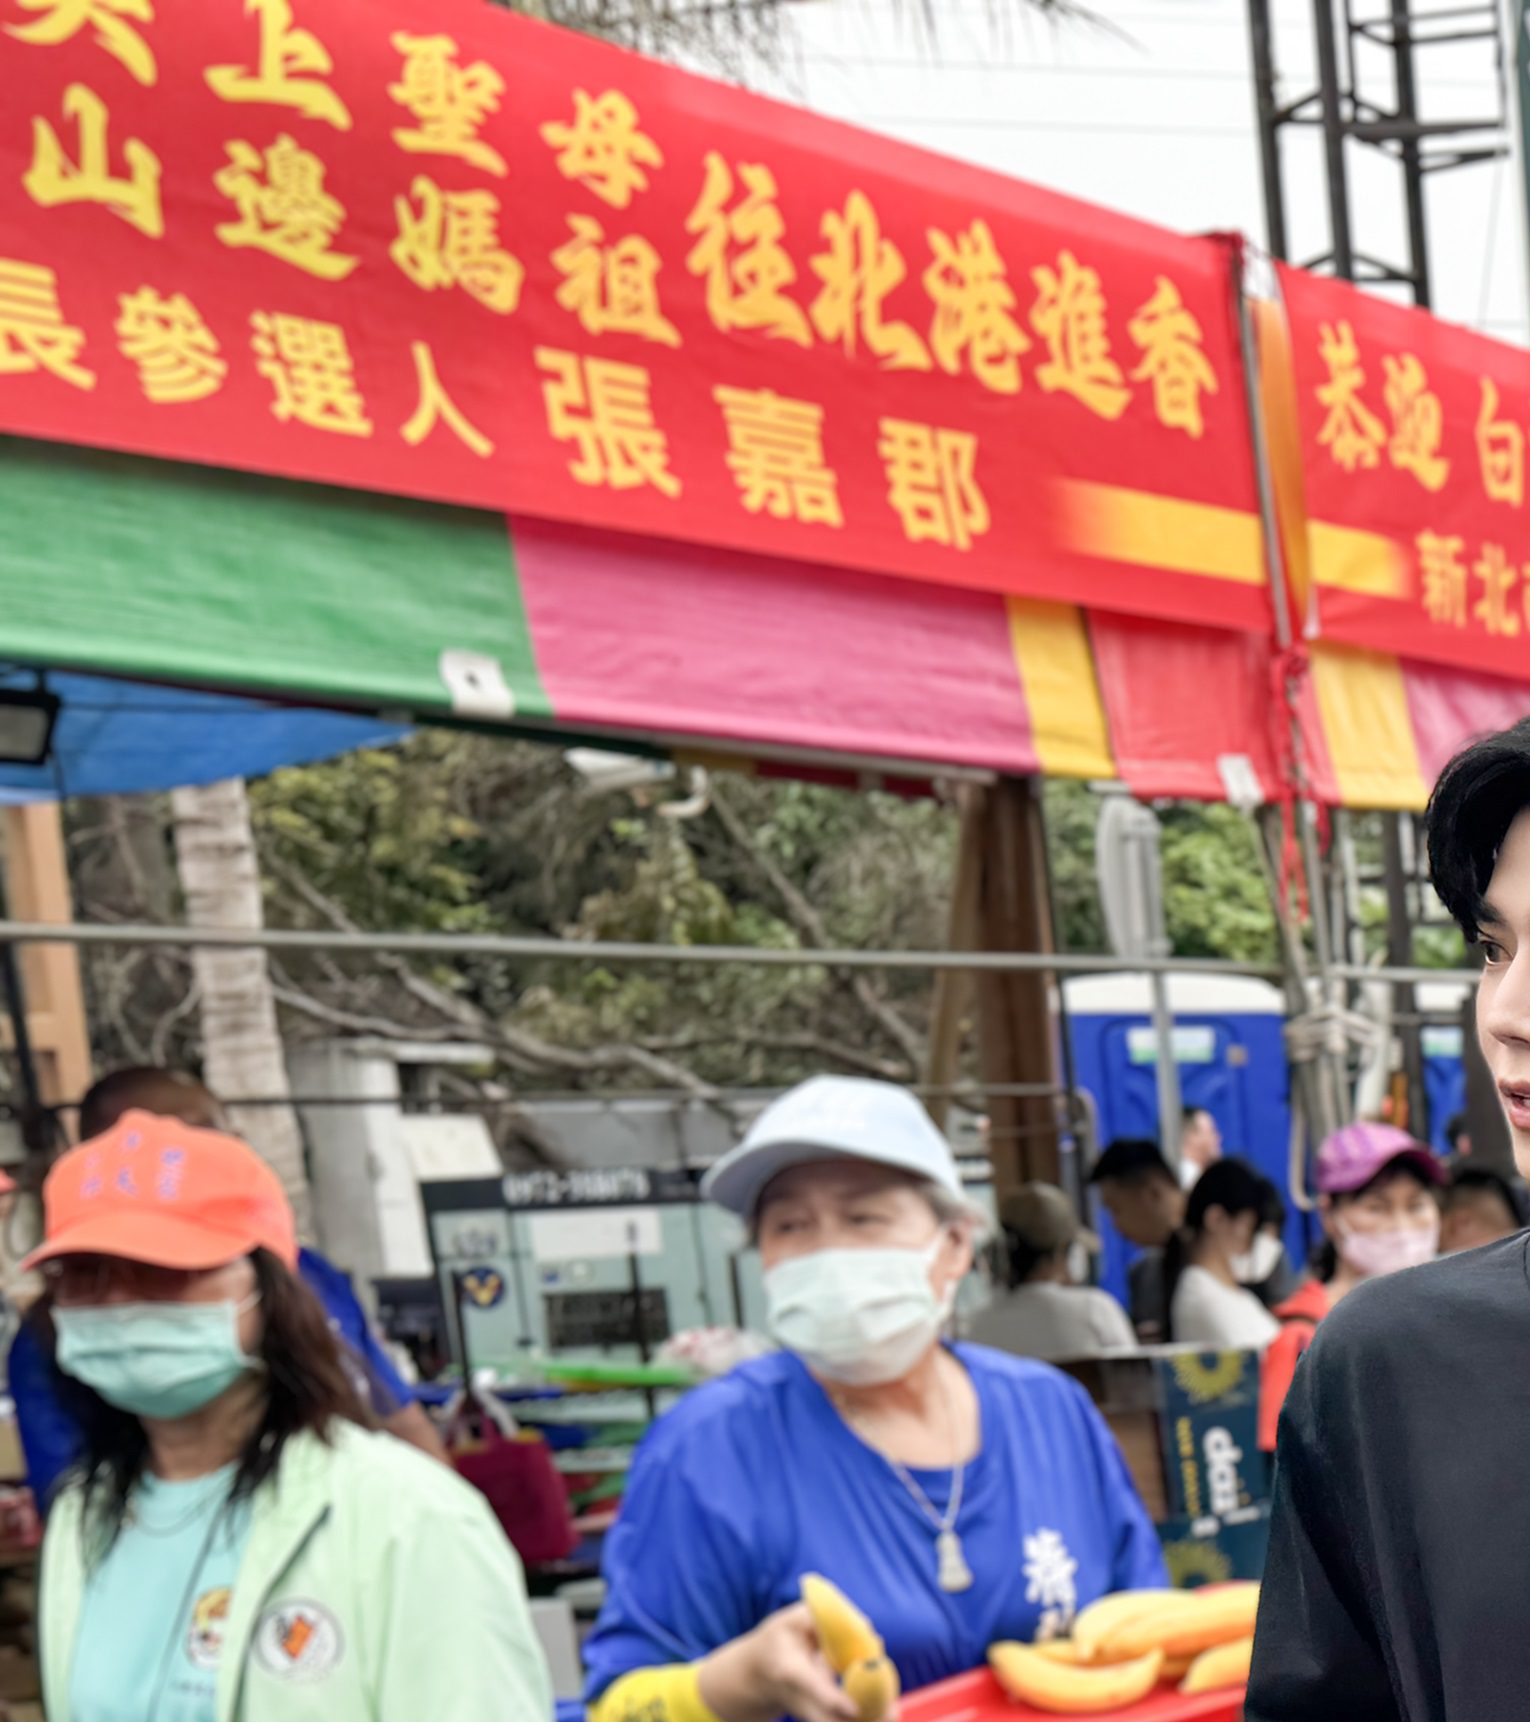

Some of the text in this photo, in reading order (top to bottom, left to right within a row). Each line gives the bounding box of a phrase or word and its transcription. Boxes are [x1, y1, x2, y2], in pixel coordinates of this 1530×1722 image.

[21, 82, 682, 348] 山邊媽祖
[684, 151, 1220, 440] 往北港進香
[532, 343, 991, 552] 張嘉郡
